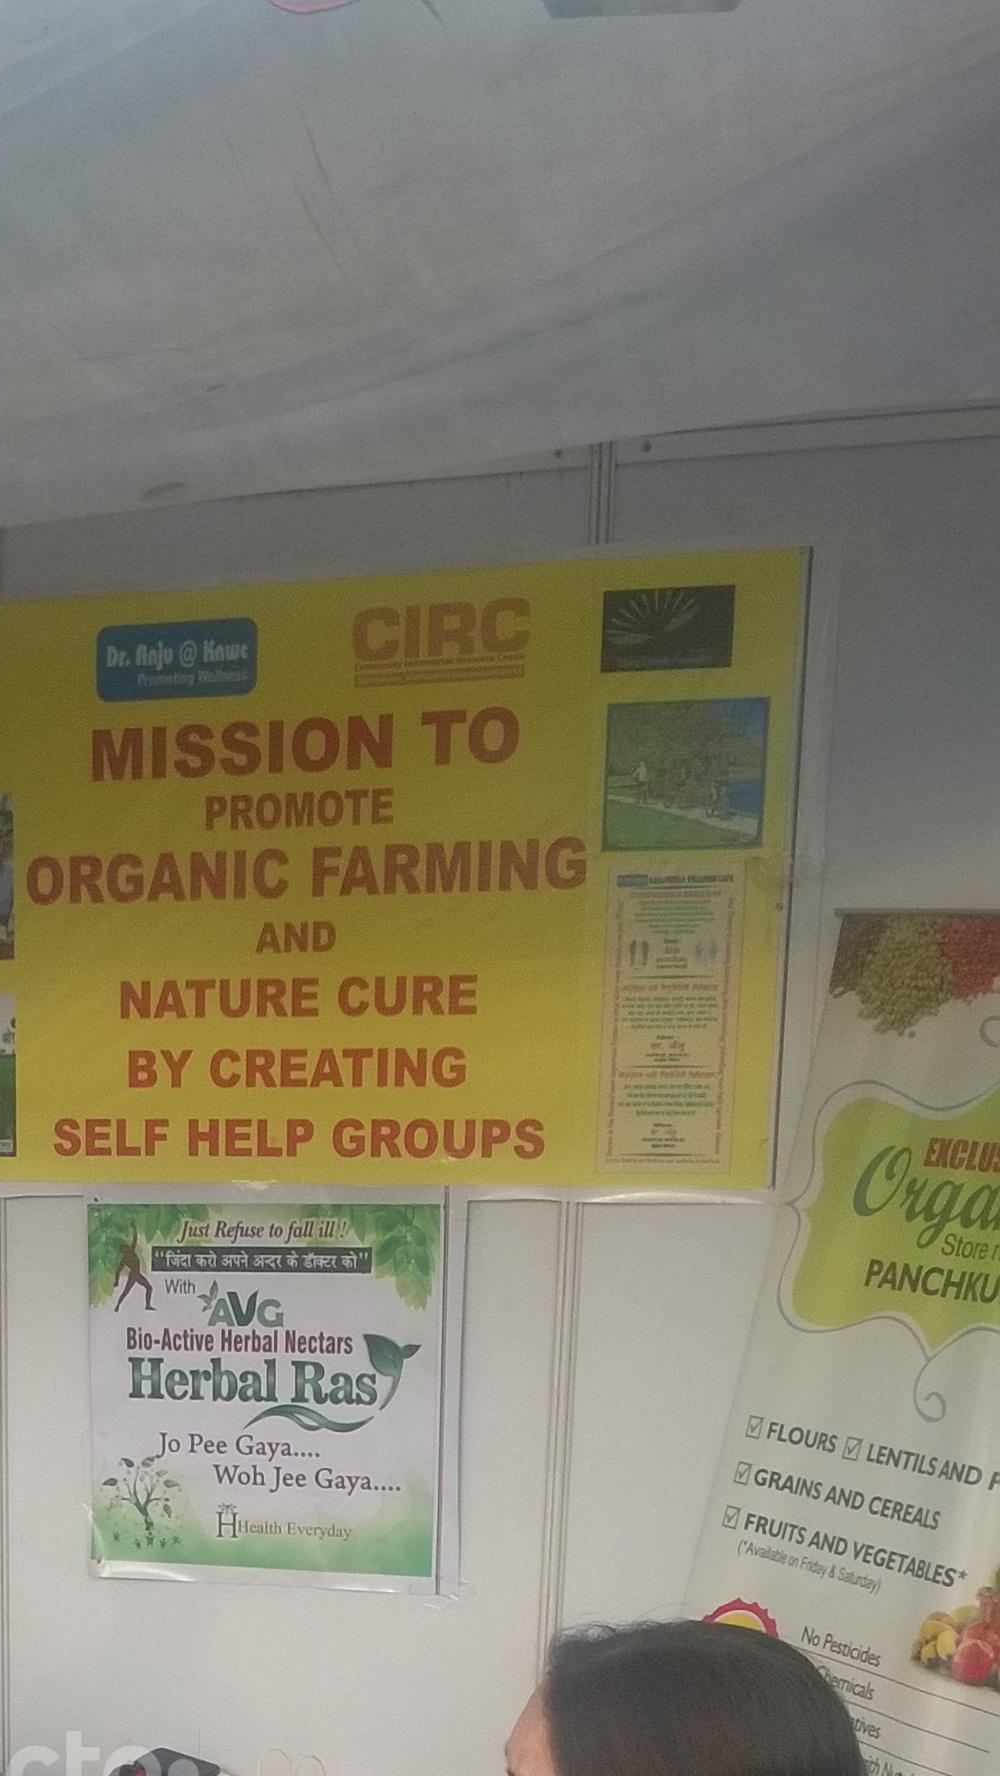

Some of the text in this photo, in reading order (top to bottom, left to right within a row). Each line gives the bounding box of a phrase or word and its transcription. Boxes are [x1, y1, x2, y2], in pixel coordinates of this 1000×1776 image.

[352, 598, 531, 662] CIRC
[106, 645, 130, 668] Dr.
[179, 640, 198, 668] @
[91, 707, 522, 781] MISSION TO
[204, 786, 395, 832] PROMOTE
[26, 835, 588, 907] ORGANIC FARMING
[255, 920, 338, 955] AND
[119, 973, 479, 1021] NATURE CURE
[128, 1045, 468, 1089] BY CREATING
[53, 1115, 546, 1160] SELF HELP GROUPS
[178, 1221, 210, 1242] Just
[214, 1221, 265, 1241] Refuse
[269, 1223, 282, 1238] to
[285, 1221, 314, 1243] fall
[941, 1233, 988, 1260] Store
[164, 1278, 196, 1296] With
[864, 1259, 1000, 1304] PANCHKU
[207, 1290, 284, 1327] AVG
[126, 1327, 353, 1355] Bio-Active Herbal Nectars
[128, 1357, 378, 1406] Herbal Ras
[156, 1432, 181, 1459] Jo
[188, 1433, 228, 1455] Pee
[766, 1421, 839, 1454] FLOURS
[866, 1443, 938, 1476] LENTILS
[938, 1459, 983, 1486] AND
[213, 1464, 267, 1487] Woh
[269, 1466, 307, 1493] Jee
[753, 1467, 942, 1531] GRAINS AND CEREALS
[287, 1521, 352, 1540] Everyday
[743, 1511, 807, 1546] FRUITS
[808, 1529, 850, 1558] AND
[788, 1554, 800, 1569] on
[800, 1556, 828, 1579] Friday
[828, 1564, 837, 1579] &
[837, 1567, 882, 1597] Saturday)
[801, 1625, 882, 1669] No Pesticides
